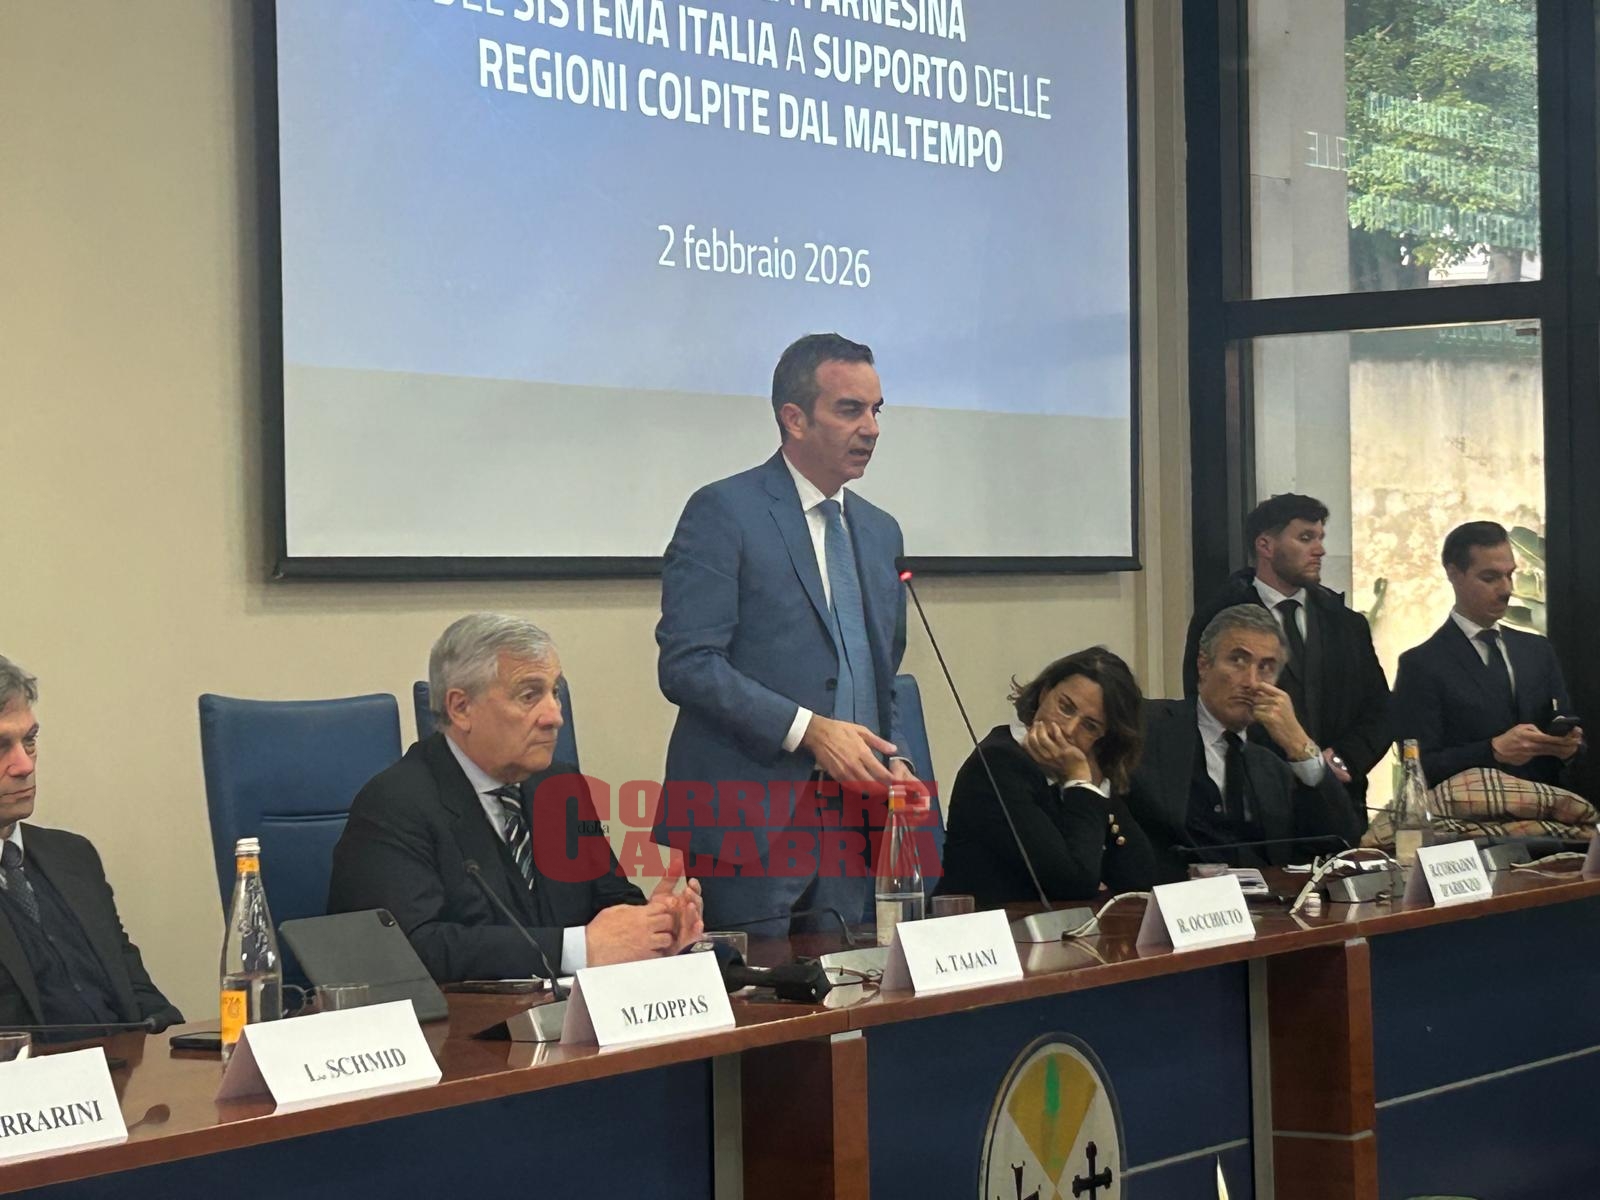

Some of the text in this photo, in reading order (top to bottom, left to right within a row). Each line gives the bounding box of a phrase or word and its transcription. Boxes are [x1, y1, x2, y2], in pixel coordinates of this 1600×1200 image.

[801, 0, 966, 41] NESINA
[679, 5, 778, 68] ITALIA
[786, 28, 806, 74] A
[813, 34, 967, 102] SUPPORTO
[974, 65, 1051, 120] DELLE
[479, 39, 1003, 172] REGIONI COLPITE DAL MALTEMPO
[658, 225, 871, 288] 2 febbraio 2026
[948, 949, 998, 971] TAJANI
[644, 995, 709, 1023] ZOPPAS
[325, 1048, 407, 1078] SCHMID
[0, 1100, 103, 1138] RRARINI
